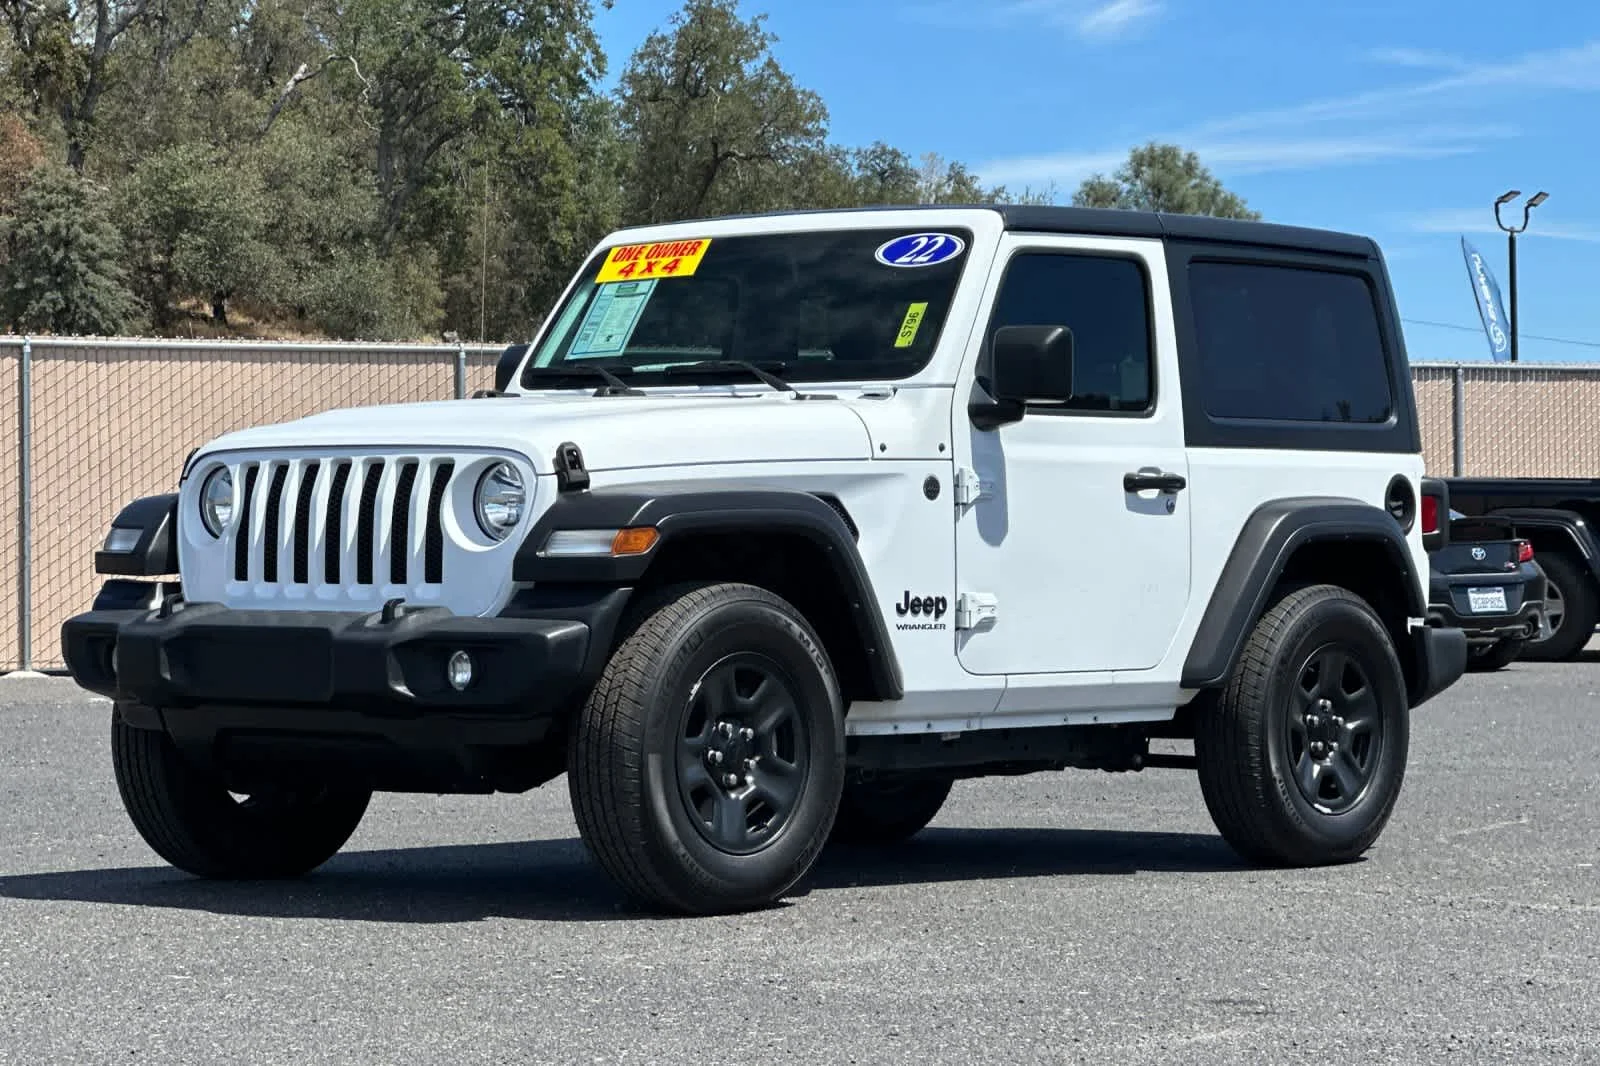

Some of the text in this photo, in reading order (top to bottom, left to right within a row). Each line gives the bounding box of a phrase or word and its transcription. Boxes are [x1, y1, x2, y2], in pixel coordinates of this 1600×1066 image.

[612, 240, 703, 262] ONE OWNER
[895, 236, 946, 263] 22
[900, 311, 920, 338] S796
[895, 590, 947, 621] Jeep
[895, 623, 946, 631] WRANGLER
